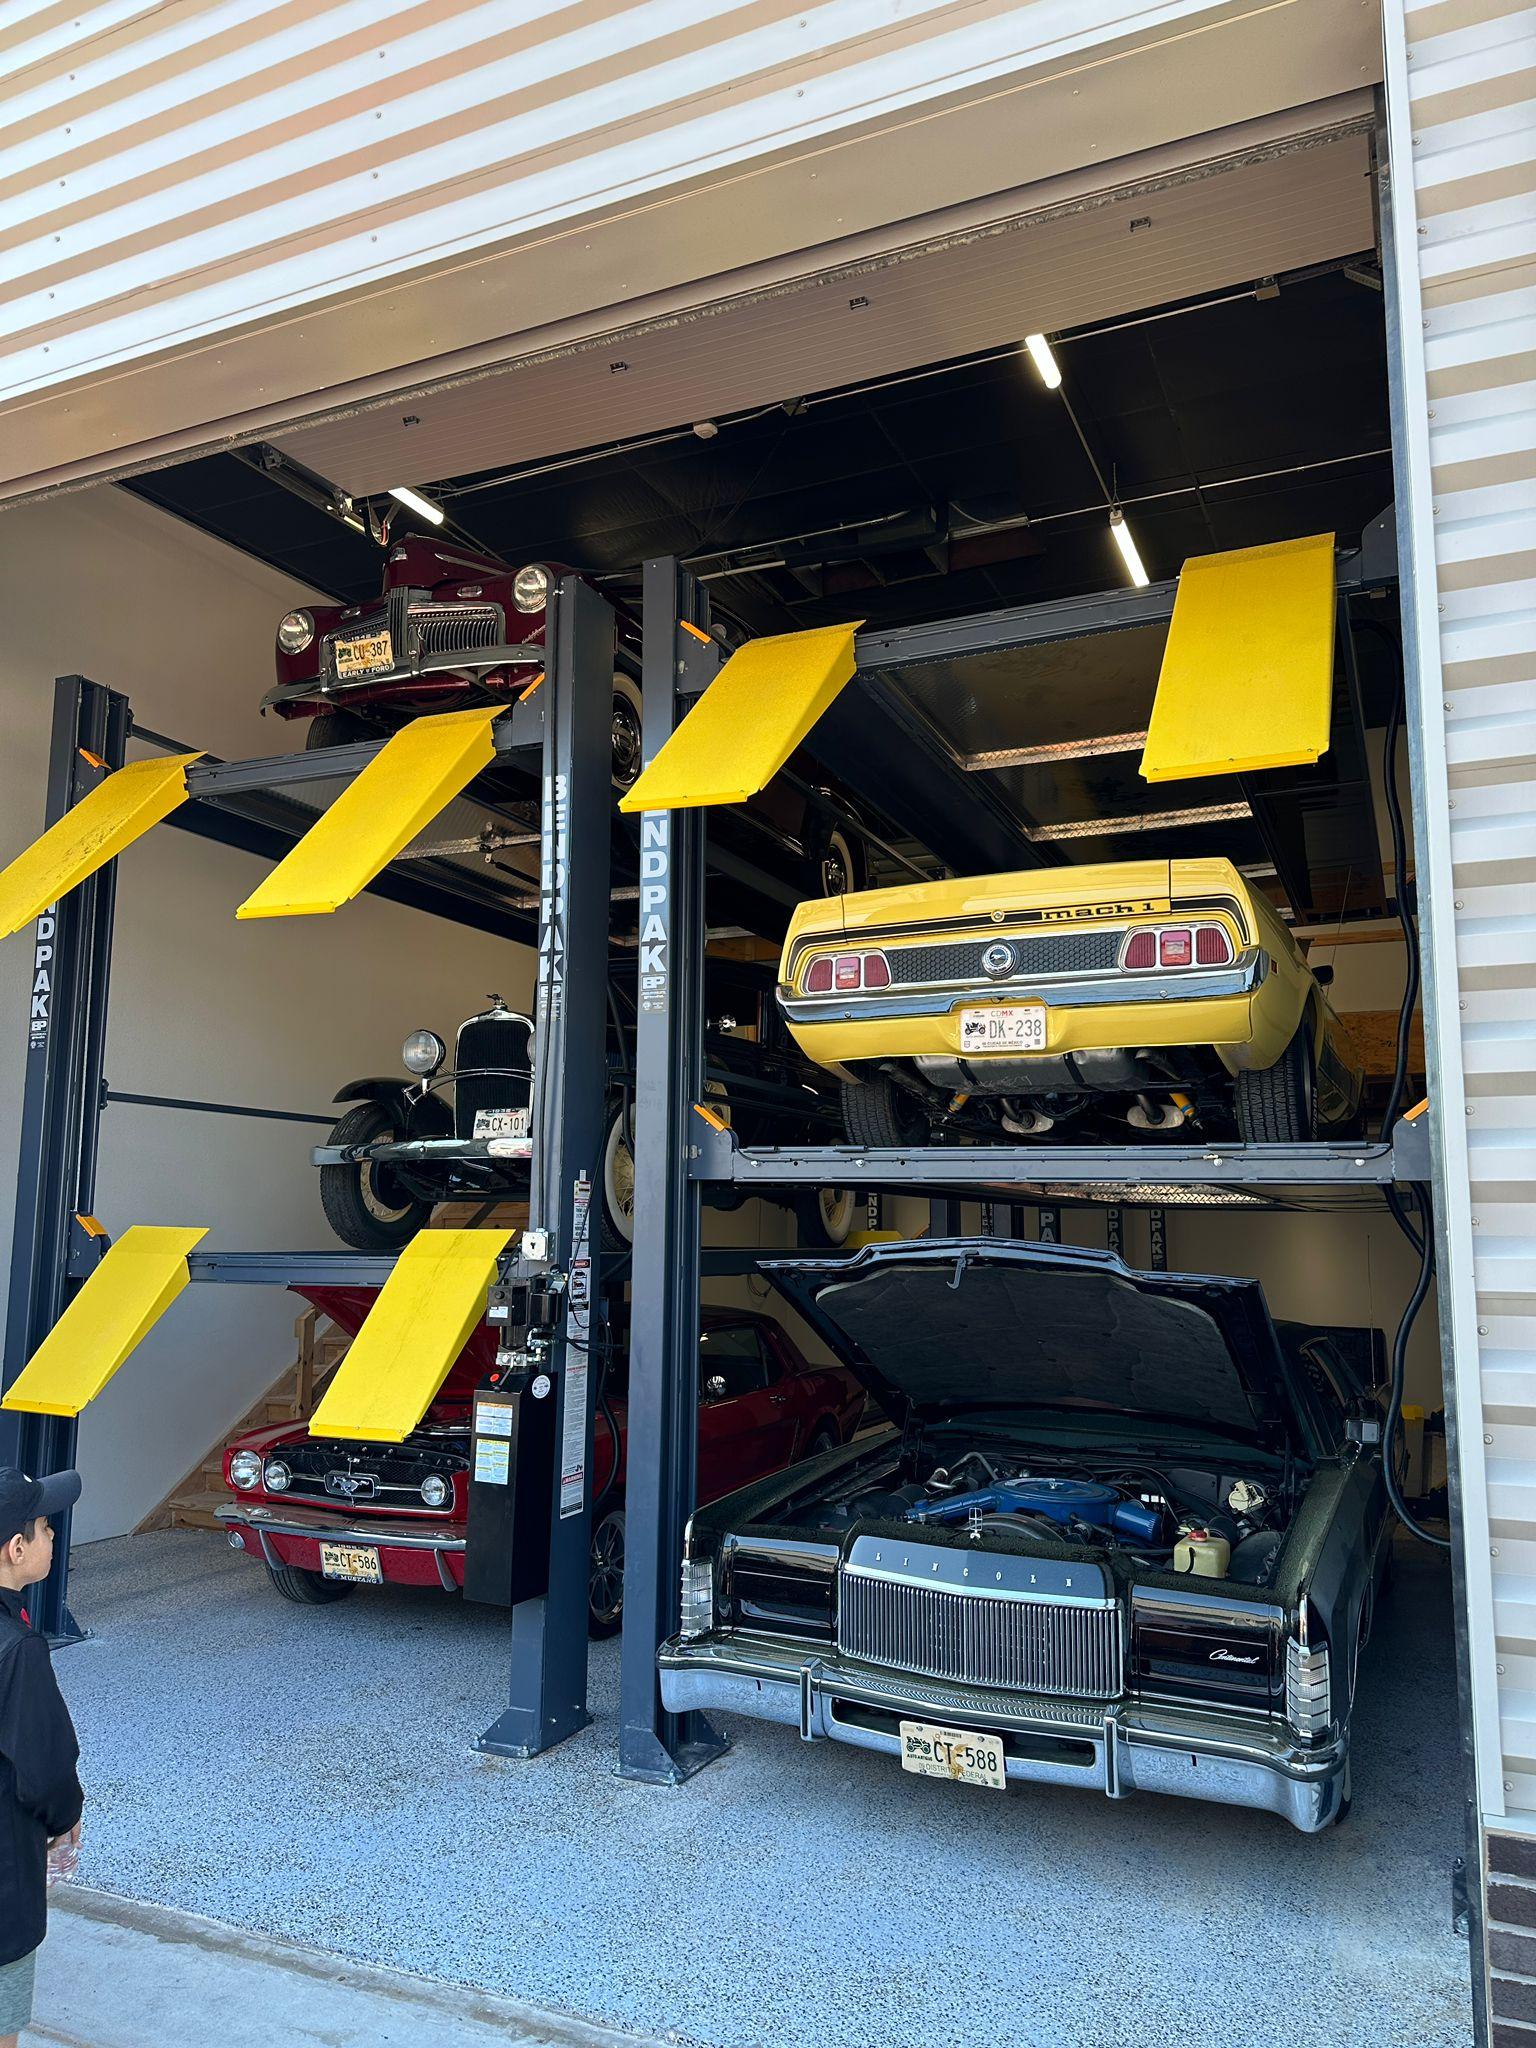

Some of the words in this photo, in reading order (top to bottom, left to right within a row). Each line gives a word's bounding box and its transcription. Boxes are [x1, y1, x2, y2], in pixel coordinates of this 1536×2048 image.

[353, 641, 388, 661] CU-387
[342, 669, 364, 678] EARLY
[371, 665, 390, 673] FORD
[641, 762, 668, 973] NDPAK
[539, 775, 567, 982] BENDPAK
[1043, 901, 1135, 920] mach
[1142, 902, 1155, 911] 1
[642, 976, 665, 990] BP
[989, 1019, 1042, 1039] DK-238
[491, 1117, 525, 1131] CX-101
[340, 1553, 377, 1570] CT-586
[875, 1552, 1072, 1587] LINCOLN
[340, 1575, 377, 1584] MUSTANG
[1209, 1649, 1260, 1665] Continental
[933, 1741, 998, 1772] CT-588
